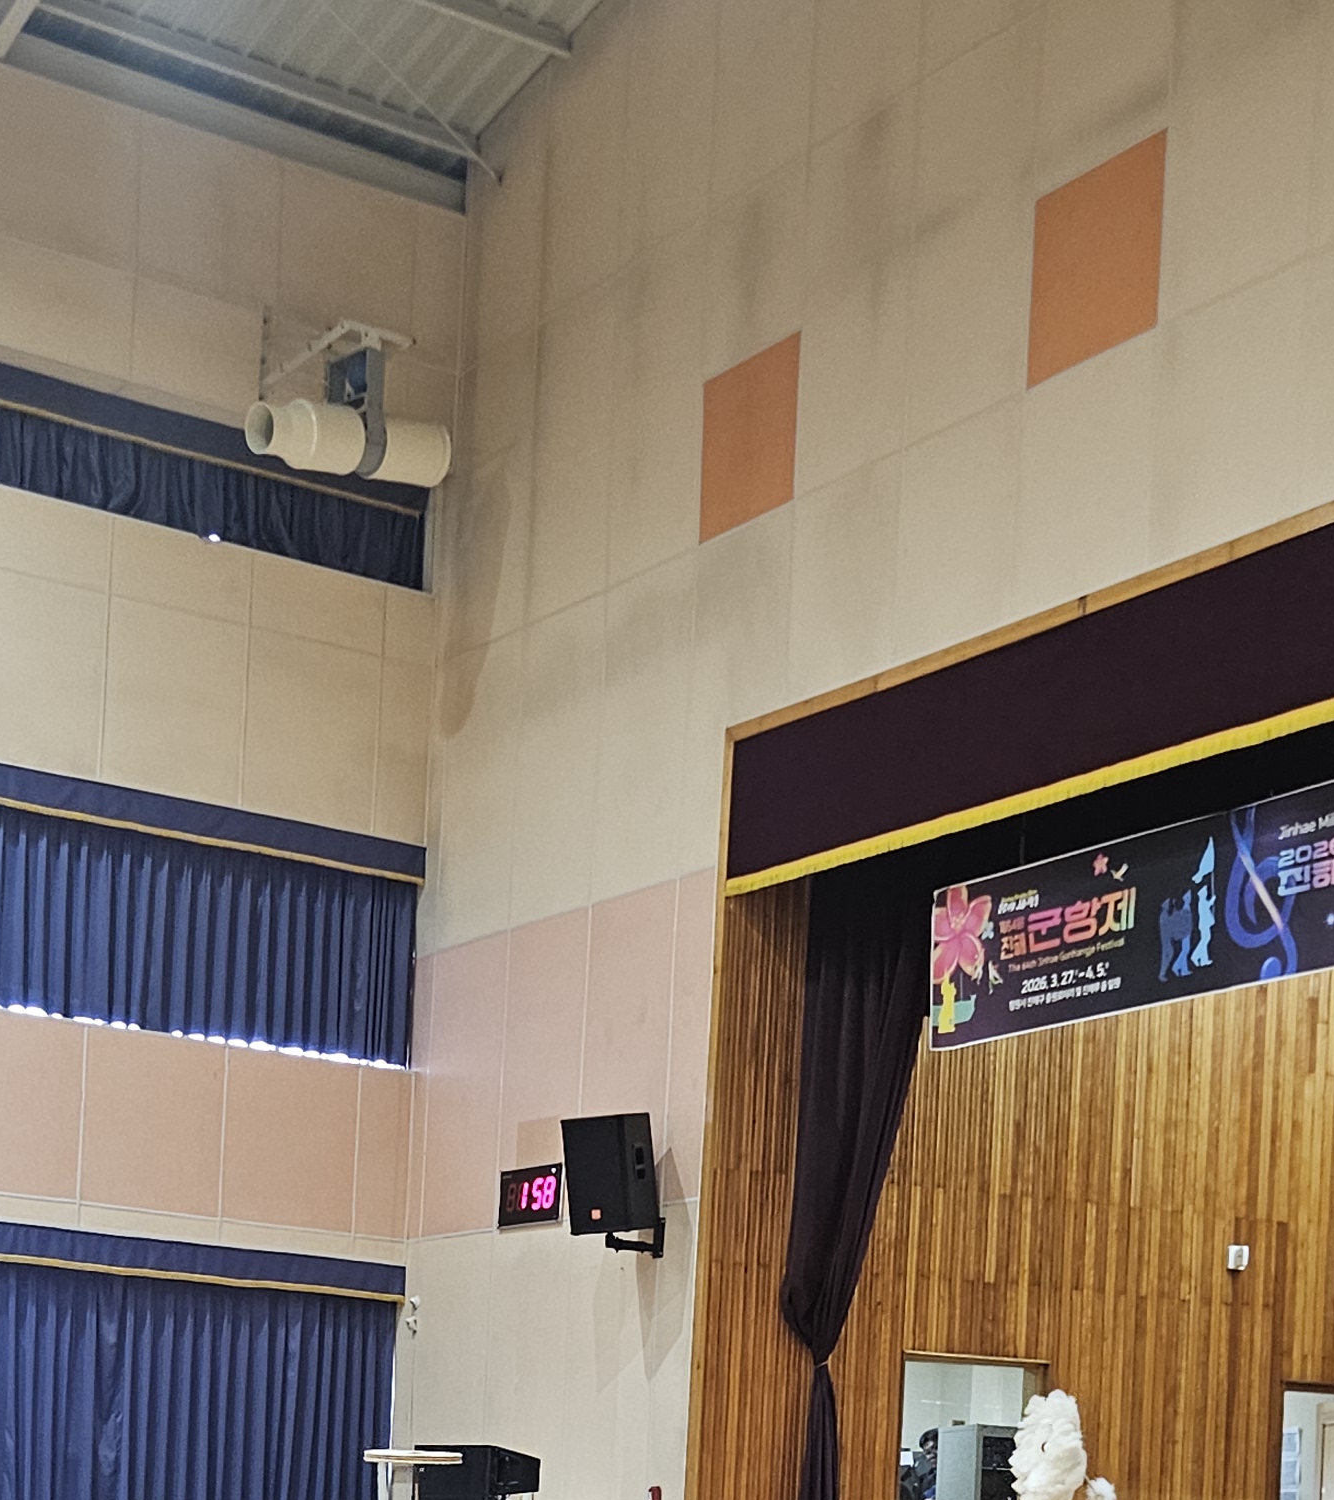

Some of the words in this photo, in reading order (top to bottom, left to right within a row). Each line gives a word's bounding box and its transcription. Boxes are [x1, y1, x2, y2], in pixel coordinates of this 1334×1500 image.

[1278, 820, 1316, 840] Jinhae
[1027, 886, 1137, 954] 군항제
[999, 933, 1027, 960] 진해
[1021, 975, 1049, 995] 2026.
[1050, 971, 1060, 988] 3.
